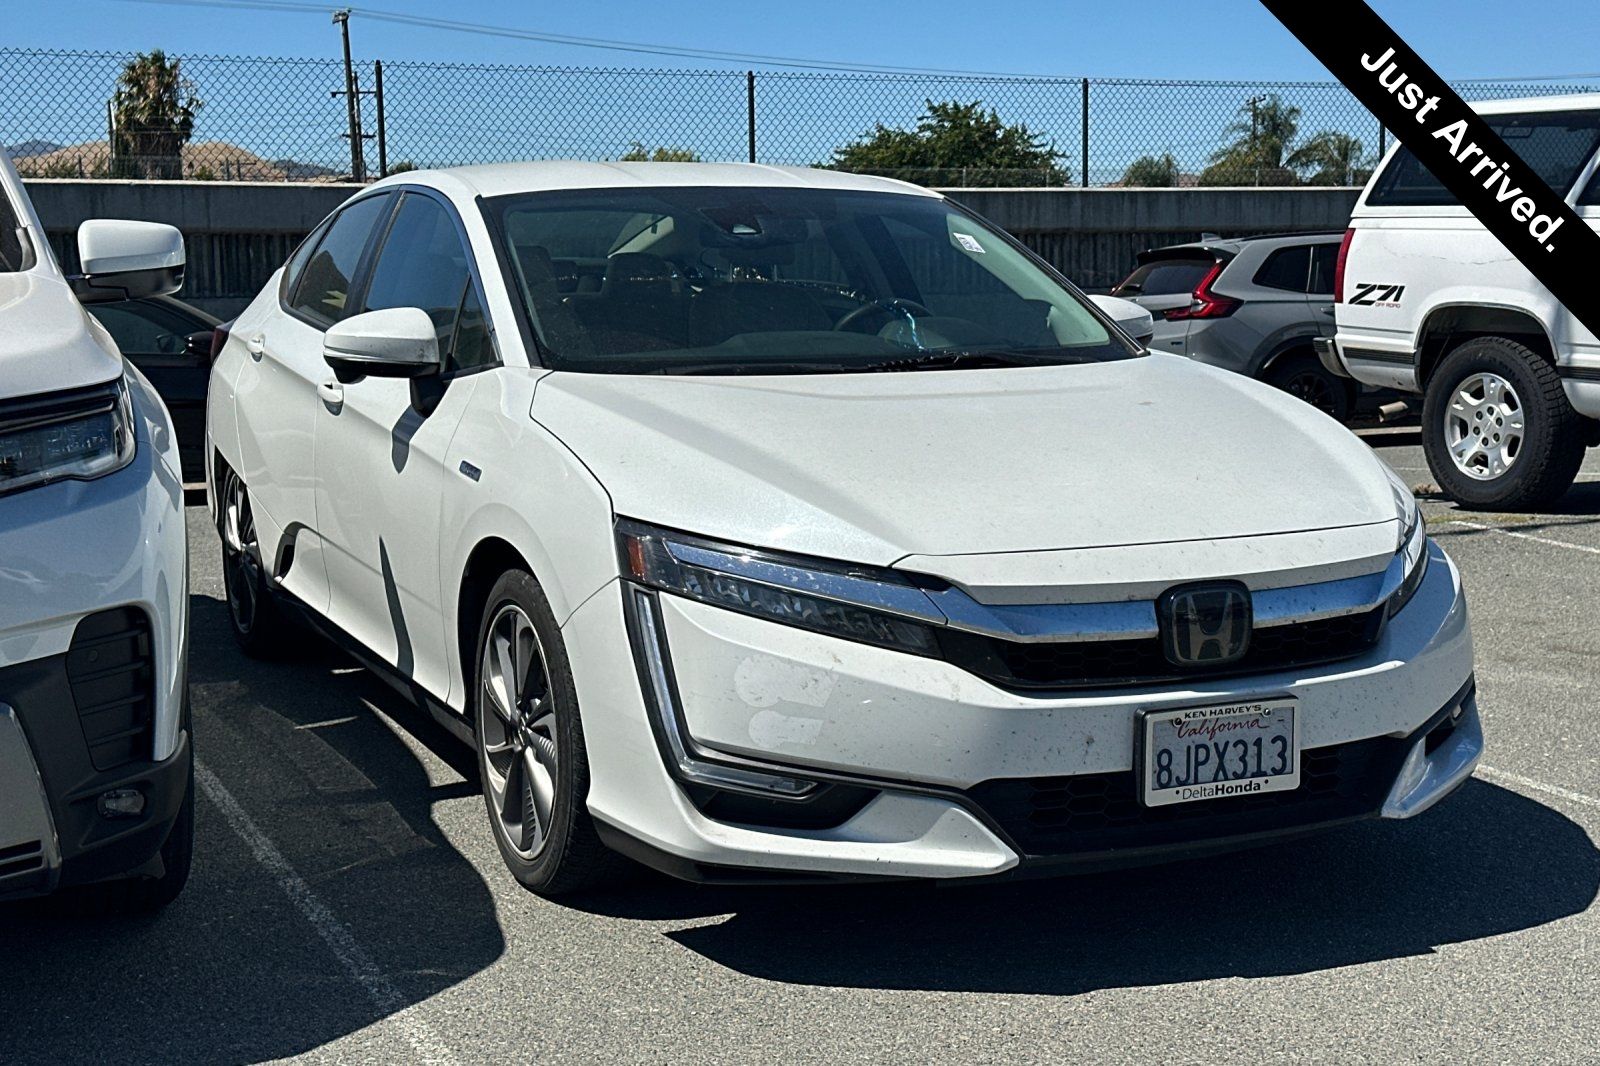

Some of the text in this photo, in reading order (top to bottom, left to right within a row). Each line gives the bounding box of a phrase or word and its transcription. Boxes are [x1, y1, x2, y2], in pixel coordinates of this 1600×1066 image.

[1348, 284, 1405, 306] Z71
[1184, 704, 1262, 720] KEN HARVEY'S
[1177, 718, 1270, 741] California
[1156, 735, 1288, 789] 8JPX313
